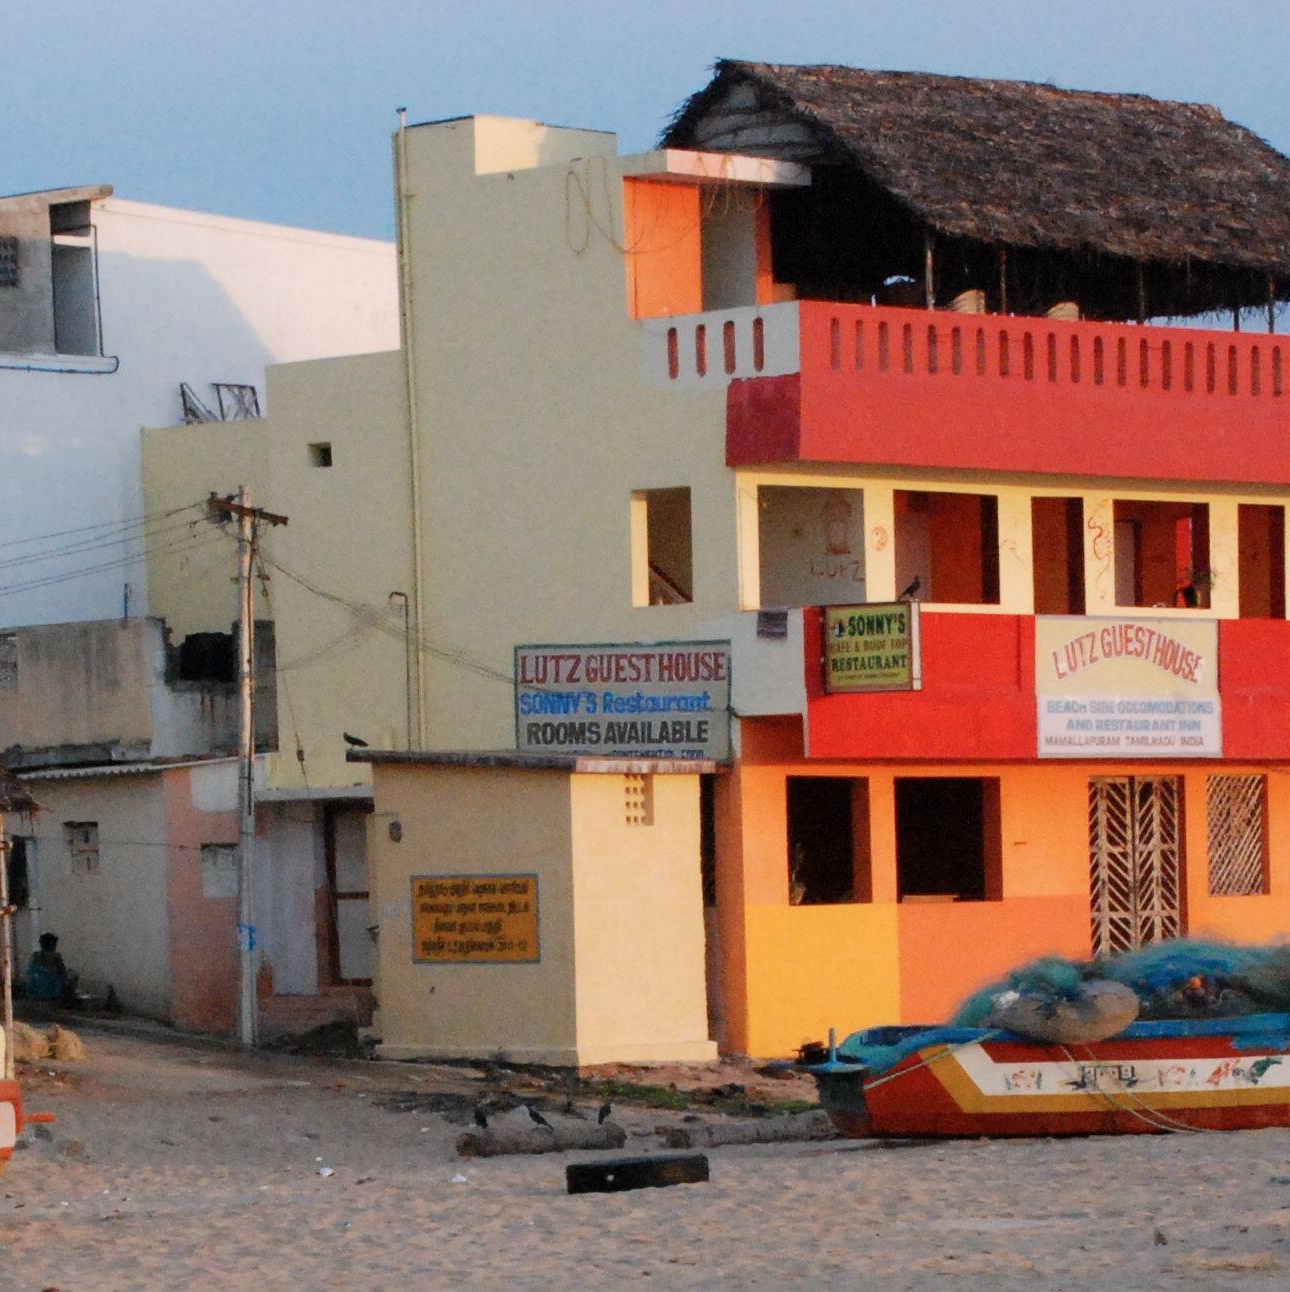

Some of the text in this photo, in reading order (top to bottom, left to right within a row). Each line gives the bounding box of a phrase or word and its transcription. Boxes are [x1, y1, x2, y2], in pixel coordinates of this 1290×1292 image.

[848, 612, 906, 636] SONNY'S
[831, 653, 906, 672] RESTAURANT
[1052, 624, 1203, 683] LUTZ GUEST HOUSE
[520, 652, 727, 684] LUTZ GUEST HOUSE
[520, 691, 598, 716] SONNY'S
[526, 720, 709, 745] ROOMS AVAILABLE
[1066, 719, 1202, 731] AND RESTAURANT INN
[1180, 736, 1204, 746] INDIA
